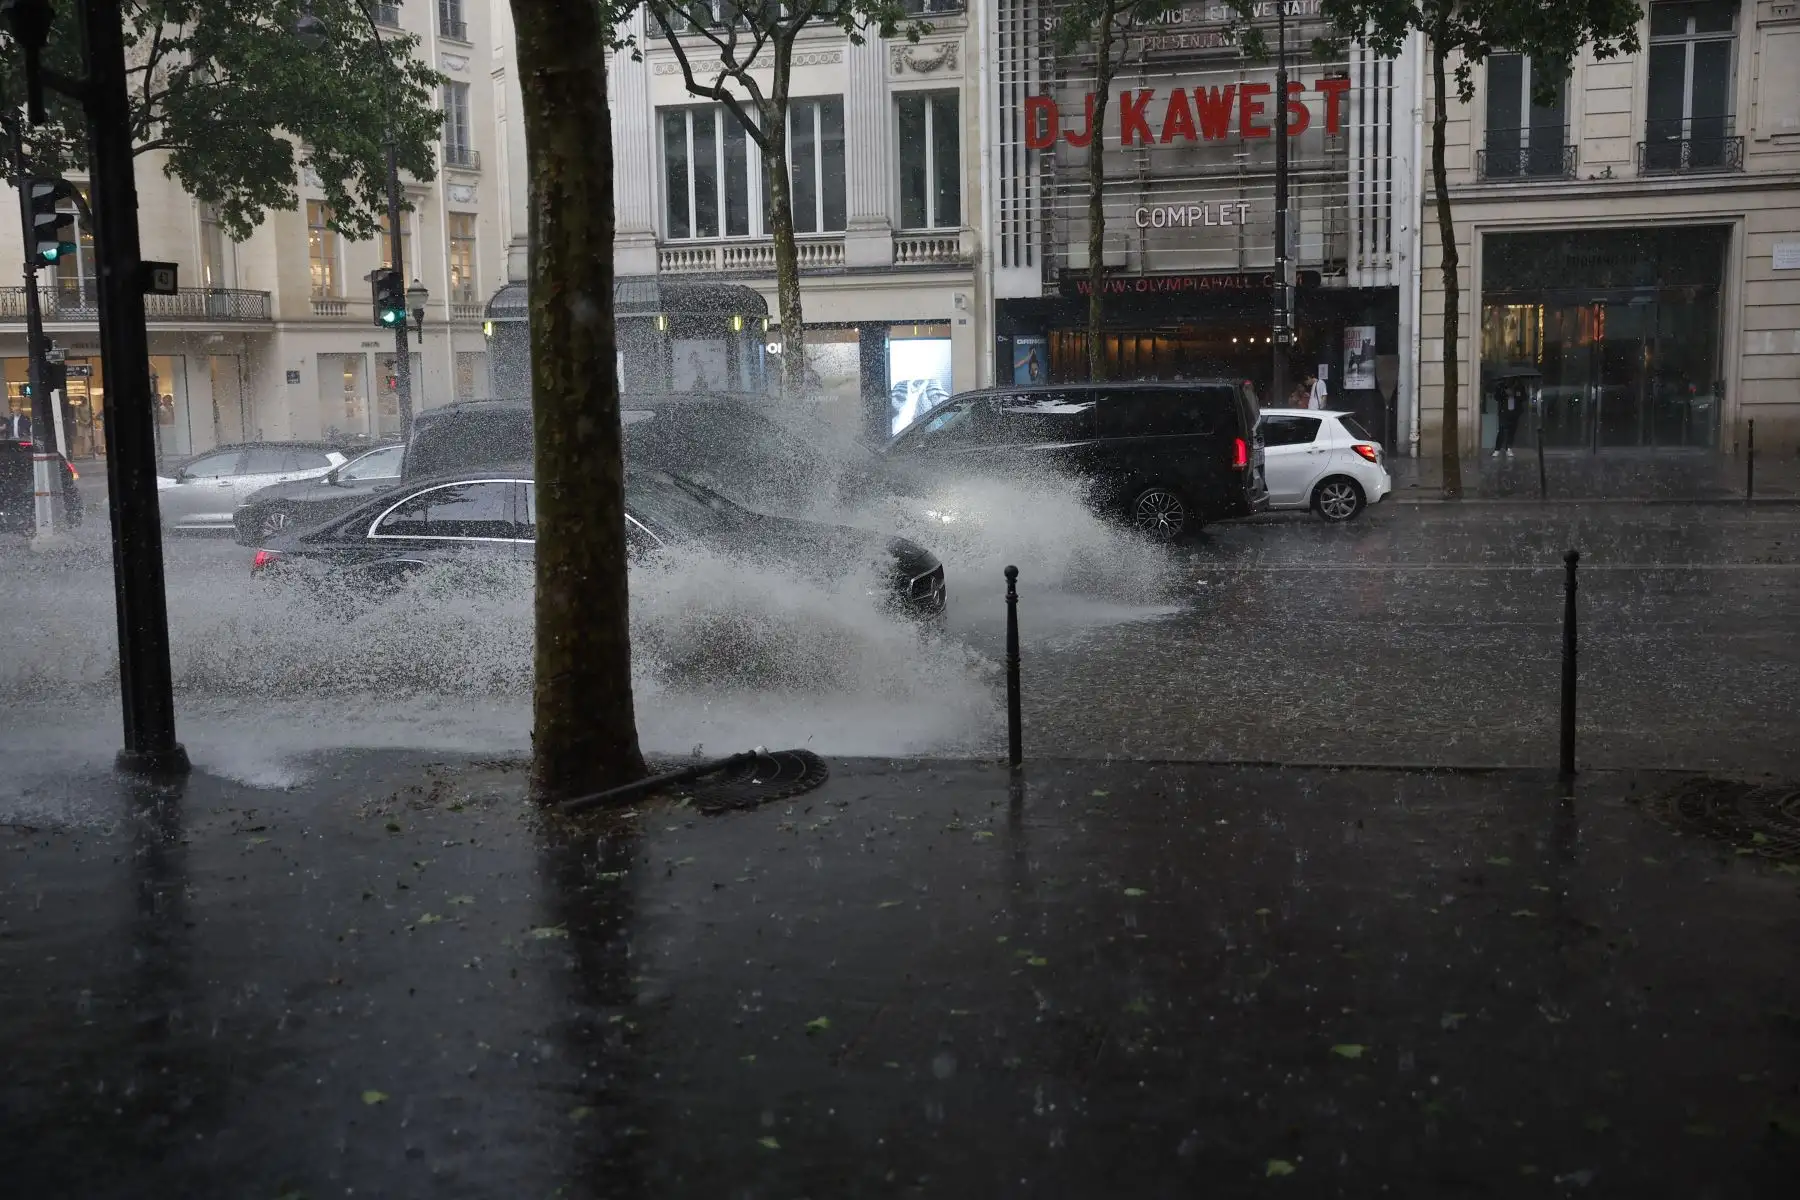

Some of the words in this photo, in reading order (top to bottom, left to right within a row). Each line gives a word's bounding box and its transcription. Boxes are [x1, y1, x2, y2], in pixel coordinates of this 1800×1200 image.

[1210, 5, 1230, 21] ET
[1236, 1, 1272, 18] LVE
[1025, 91, 1098, 150] DJ
[1119, 78, 1351, 146] KAWEST
[1135, 203, 1251, 228] COMPLET
[1077, 272, 1304, 295] WW.OLYMPIAHALL.CM
